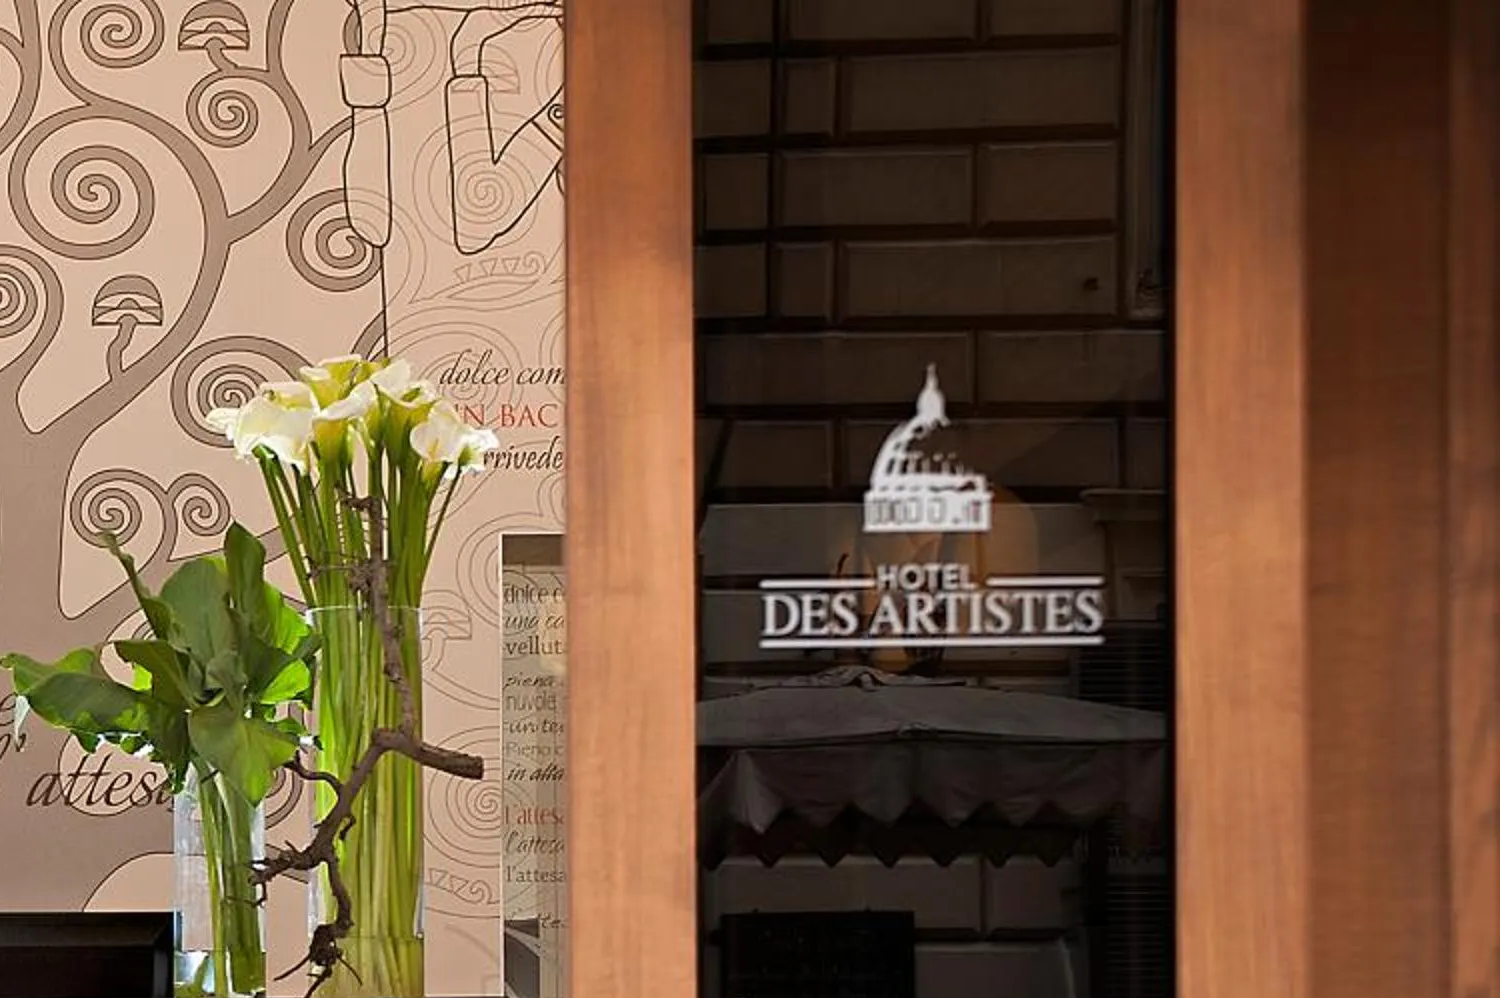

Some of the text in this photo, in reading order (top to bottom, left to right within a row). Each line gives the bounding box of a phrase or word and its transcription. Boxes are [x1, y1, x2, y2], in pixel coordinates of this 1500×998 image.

[438, 348, 509, 386] dolce
[454, 403, 559, 428] N BAC
[876, 563, 976, 591] HOTEL
[763, 588, 1104, 636] DES ARTISTES
